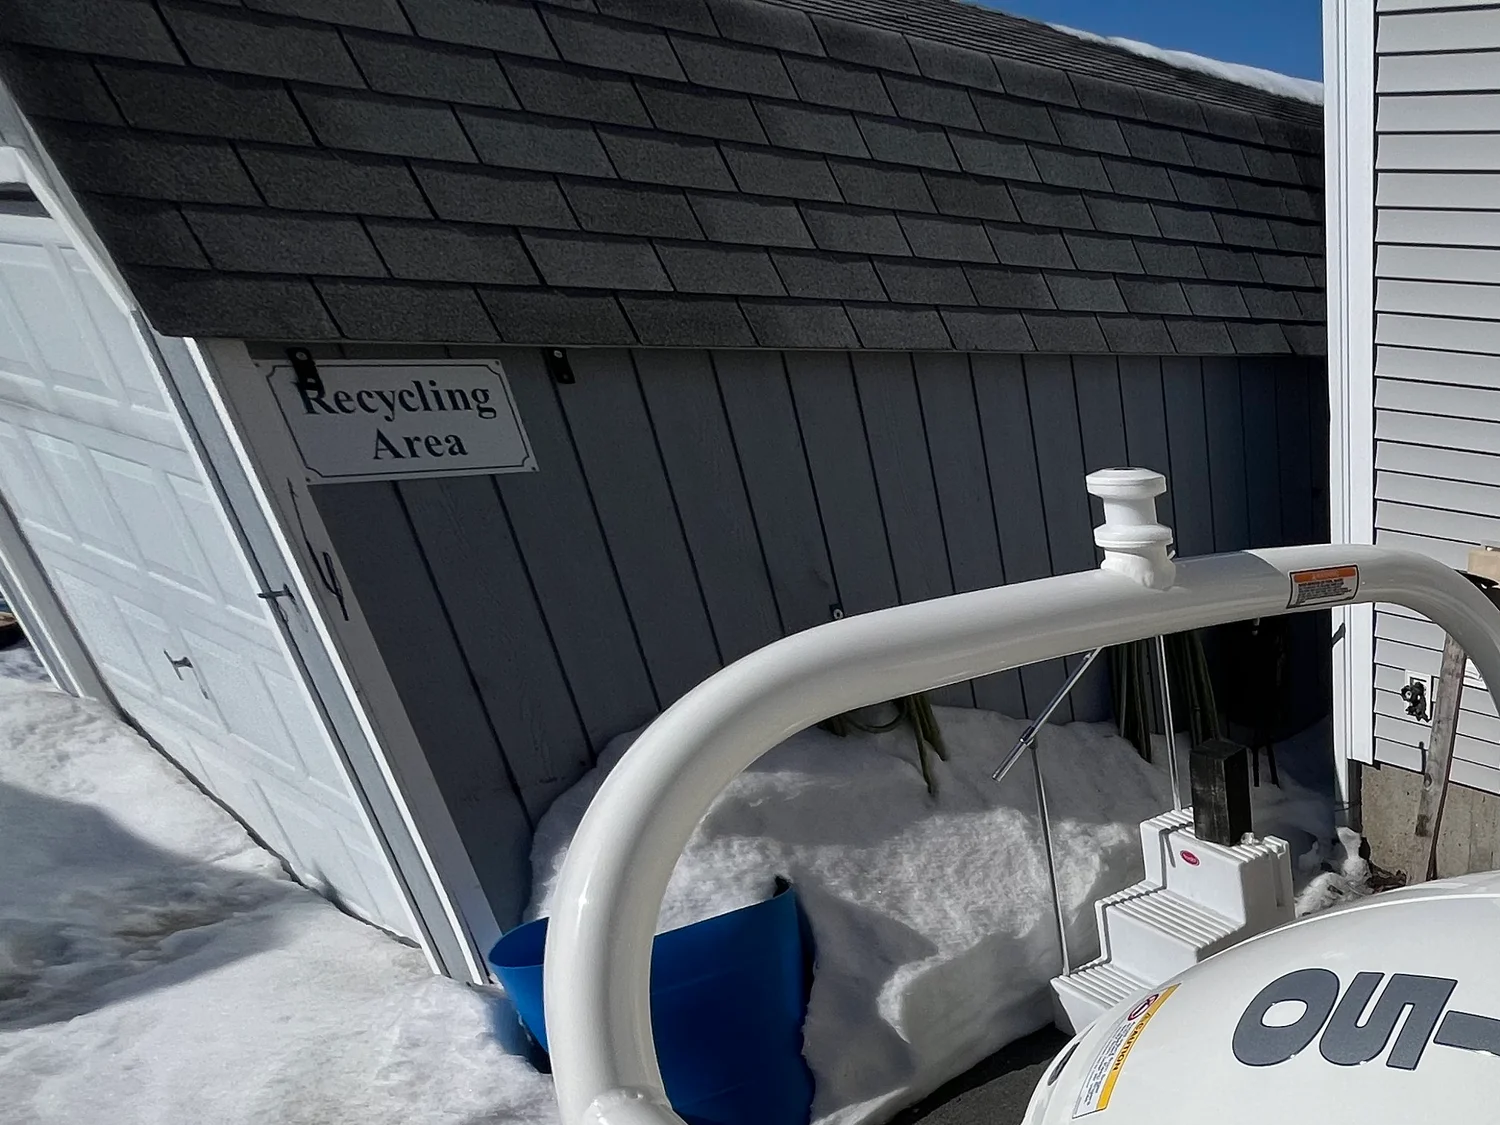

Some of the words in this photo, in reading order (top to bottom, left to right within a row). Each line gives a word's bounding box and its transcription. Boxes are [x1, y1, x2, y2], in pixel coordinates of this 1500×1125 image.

[290, 379, 497, 422] Recycling
[373, 428, 469, 460] Area
[1112, 1022, 1145, 1071] CAUTION
